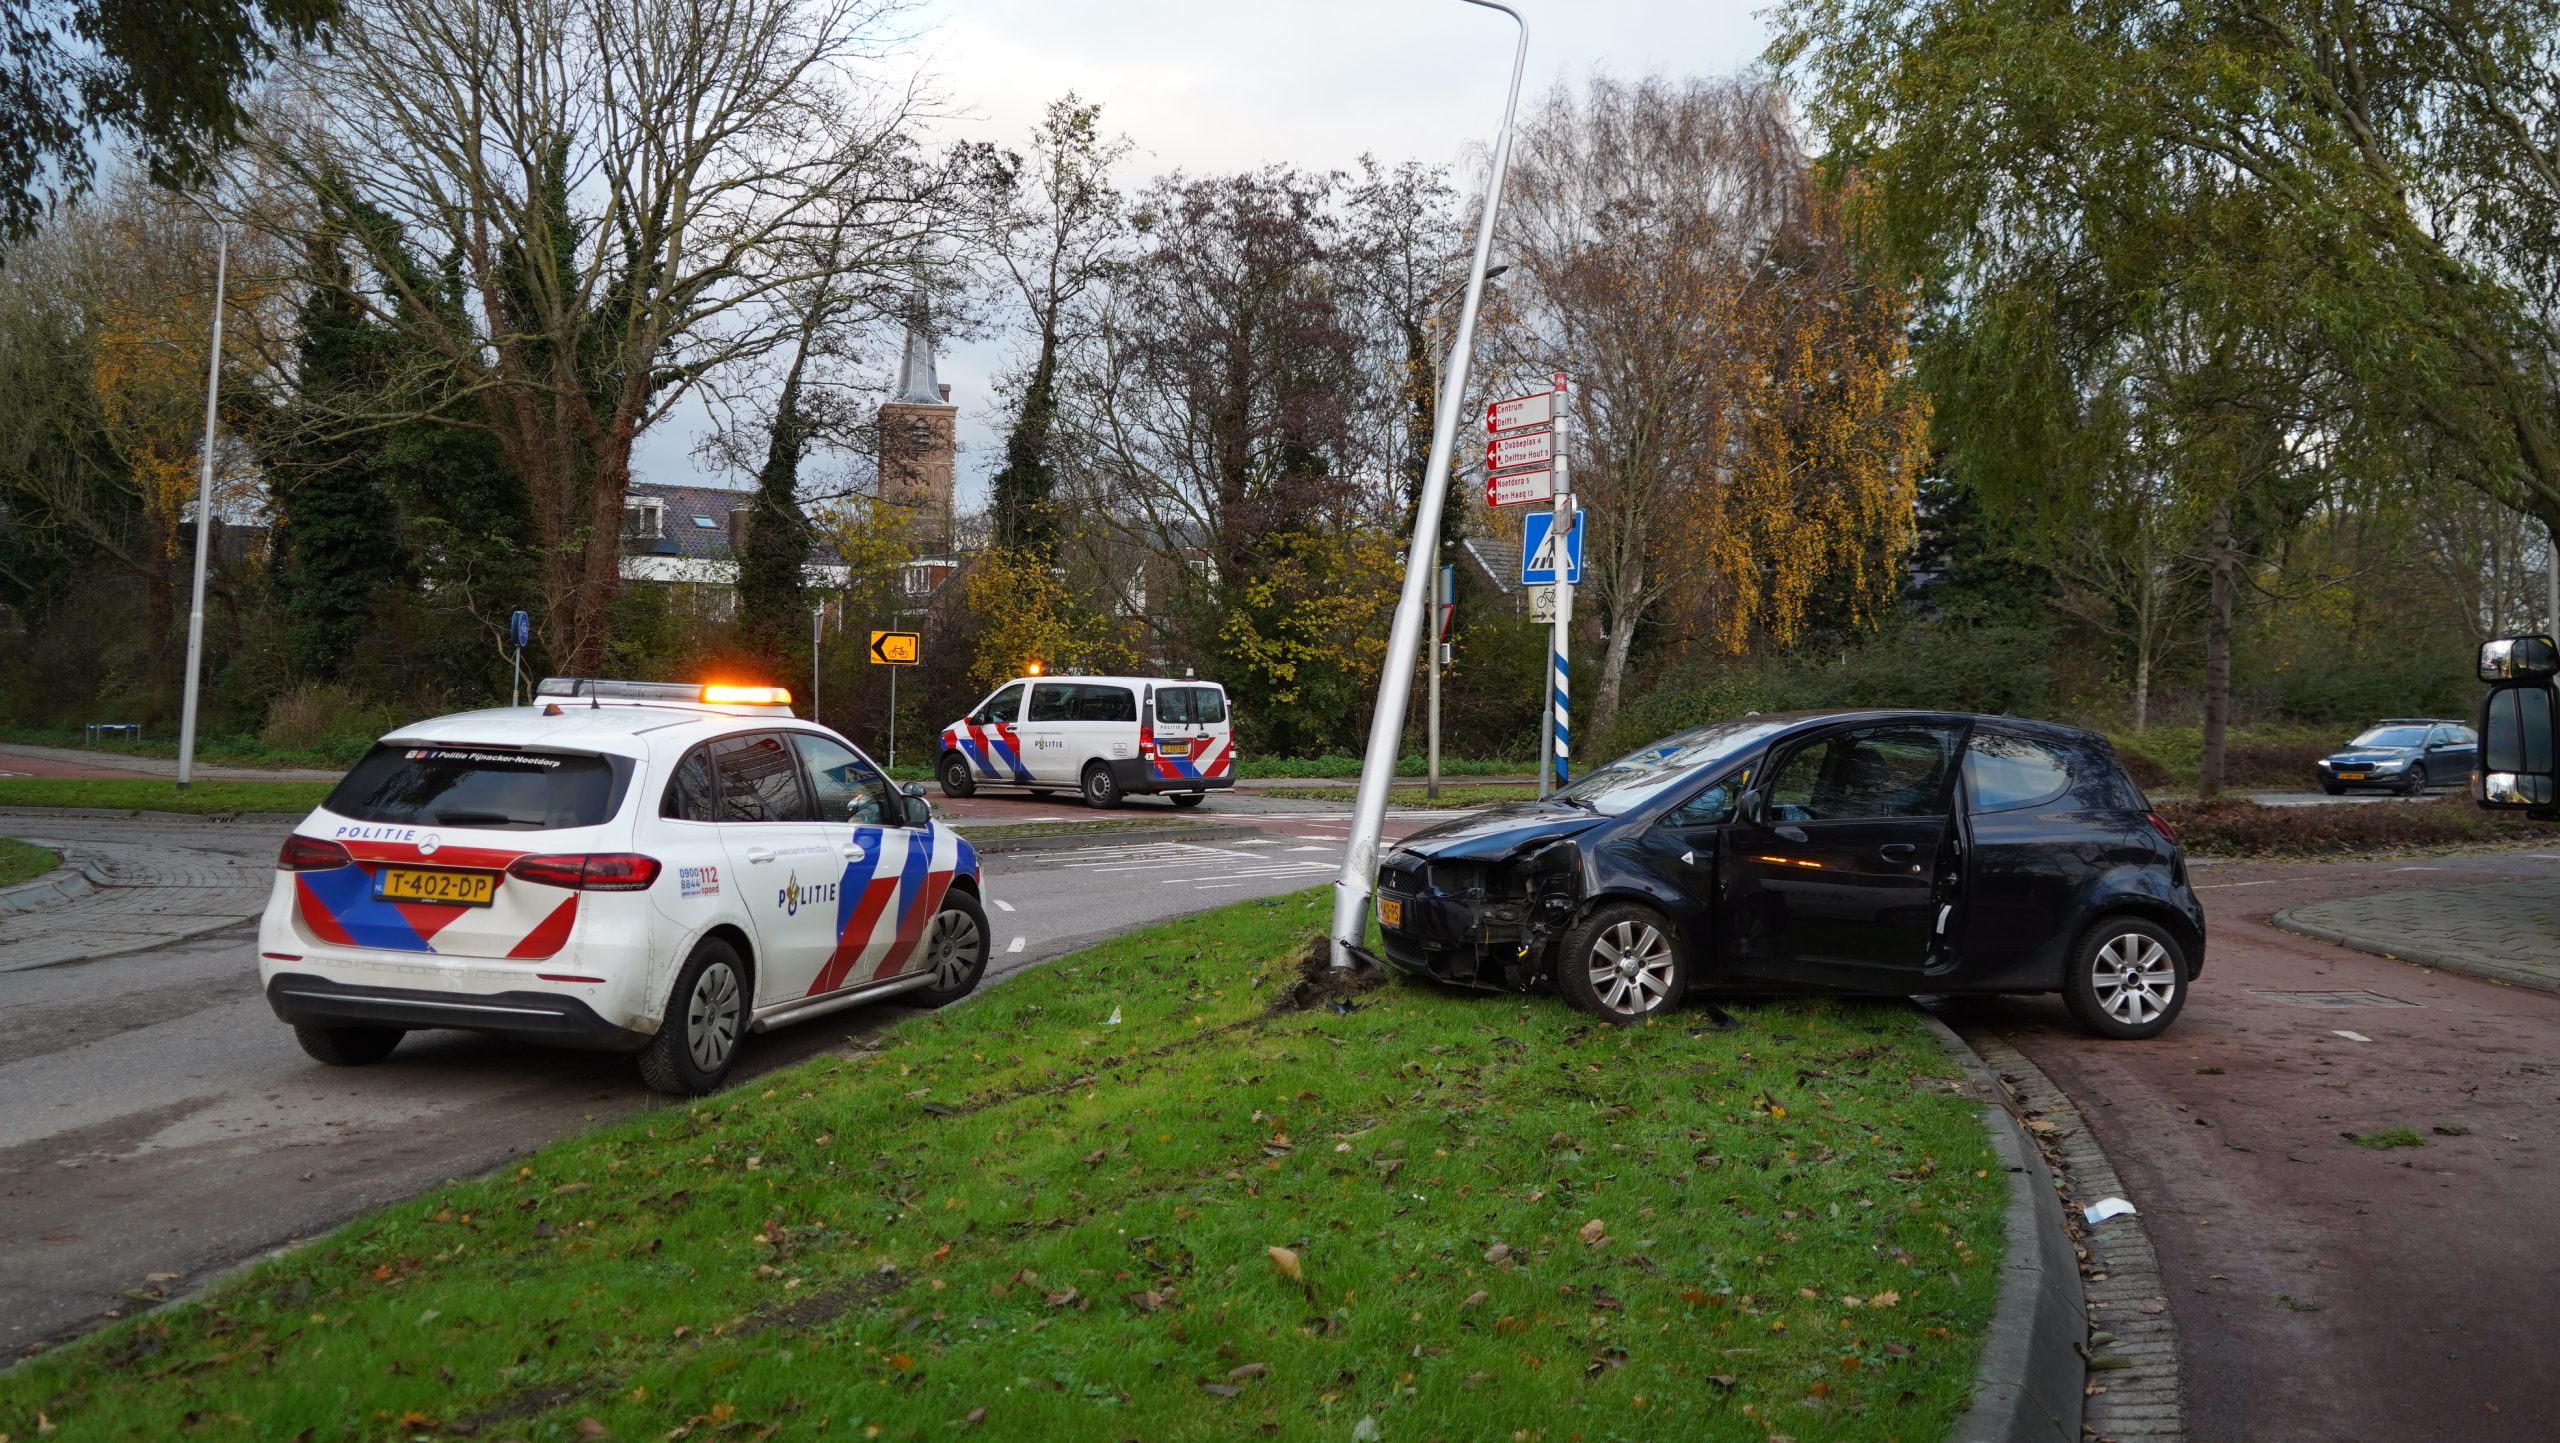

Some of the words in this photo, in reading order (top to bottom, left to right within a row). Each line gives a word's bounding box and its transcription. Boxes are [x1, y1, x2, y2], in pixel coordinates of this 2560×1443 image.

[1498, 403, 1523, 413] Centrum
[1498, 417, 1512, 426] Delft
[1505, 439, 1536, 450] Dobbeplas
[1505, 452, 1527, 462] Delftse
[1529, 450, 1543, 458] Hout
[1498, 478, 1525, 488] Nootdorp
[1511, 491, 1526, 499] Haag
[1035, 740, 1063, 750] POLITIE
[438, 751, 467, 759] Politie
[469, 752, 561, 768] Pijnacker-Nootdorp
[336, 826, 416, 841] POLITIE
[680, 867, 699, 878] 0900
[700, 866, 719, 883] 112
[374, 884, 383, 892] NL
[393, 872, 487, 898] T-402-DP
[681, 879, 700, 889] 8844
[701, 884, 720, 896] spoed
[778, 883, 836, 916] POLITIE
